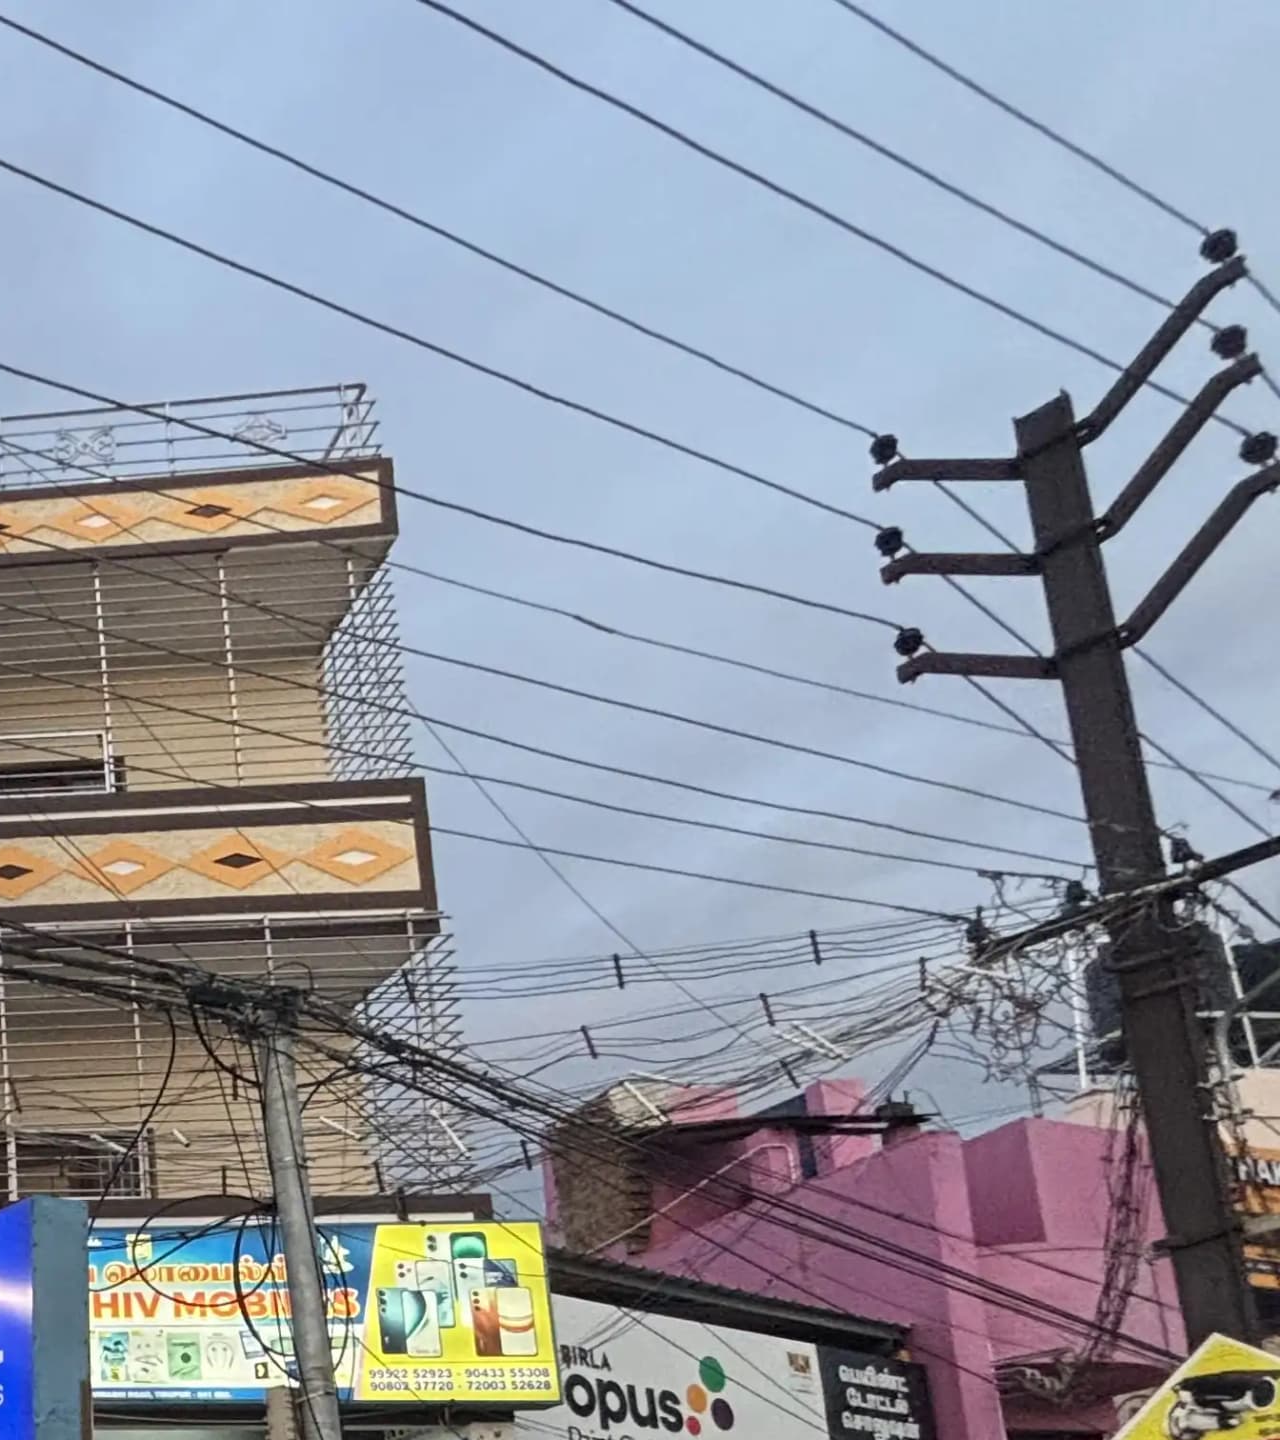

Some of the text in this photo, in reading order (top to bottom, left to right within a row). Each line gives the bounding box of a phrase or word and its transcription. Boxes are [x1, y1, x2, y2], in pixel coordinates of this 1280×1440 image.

[93, 1289, 358, 1319] HIV MOBIS
[559, 1344, 611, 1372] BIRLA
[564, 1372, 684, 1433] opus
